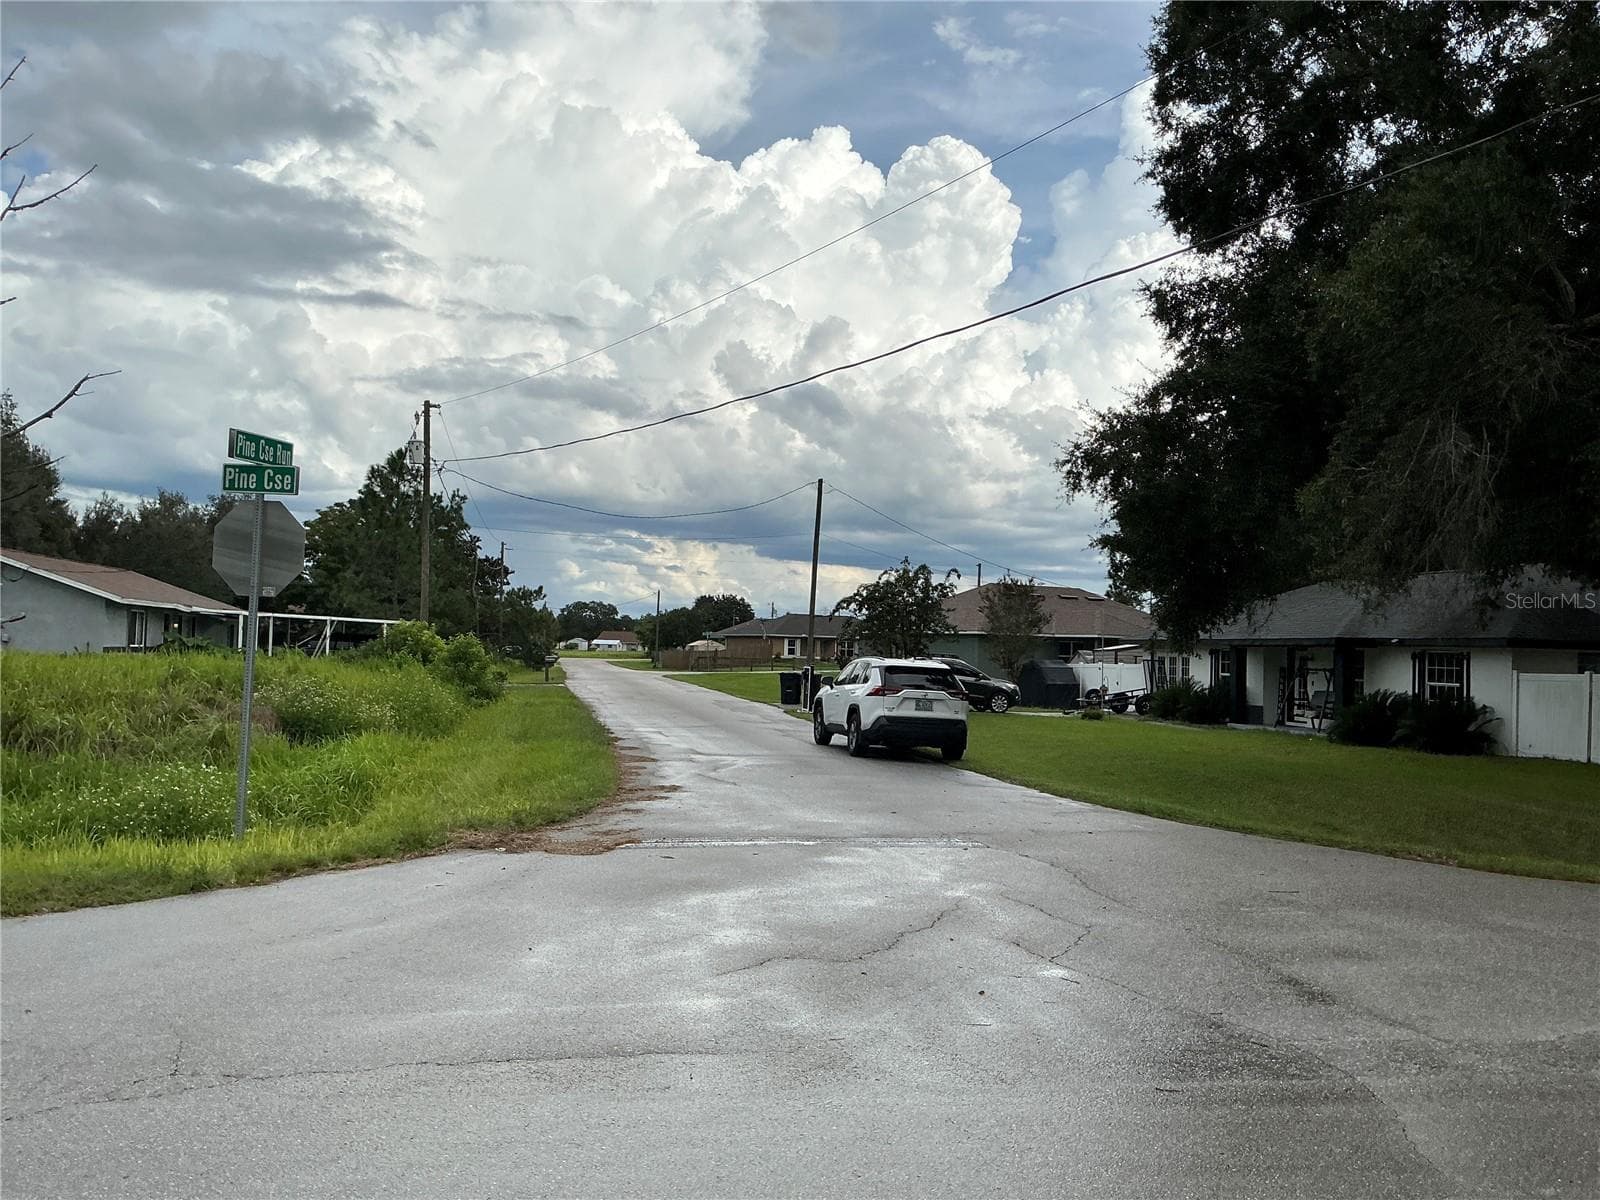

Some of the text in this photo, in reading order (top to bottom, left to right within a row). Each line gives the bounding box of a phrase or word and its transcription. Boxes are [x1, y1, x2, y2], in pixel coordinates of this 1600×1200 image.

[237, 434, 291, 465] Pine Cse Run
[225, 467, 291, 490] Pine Cse
